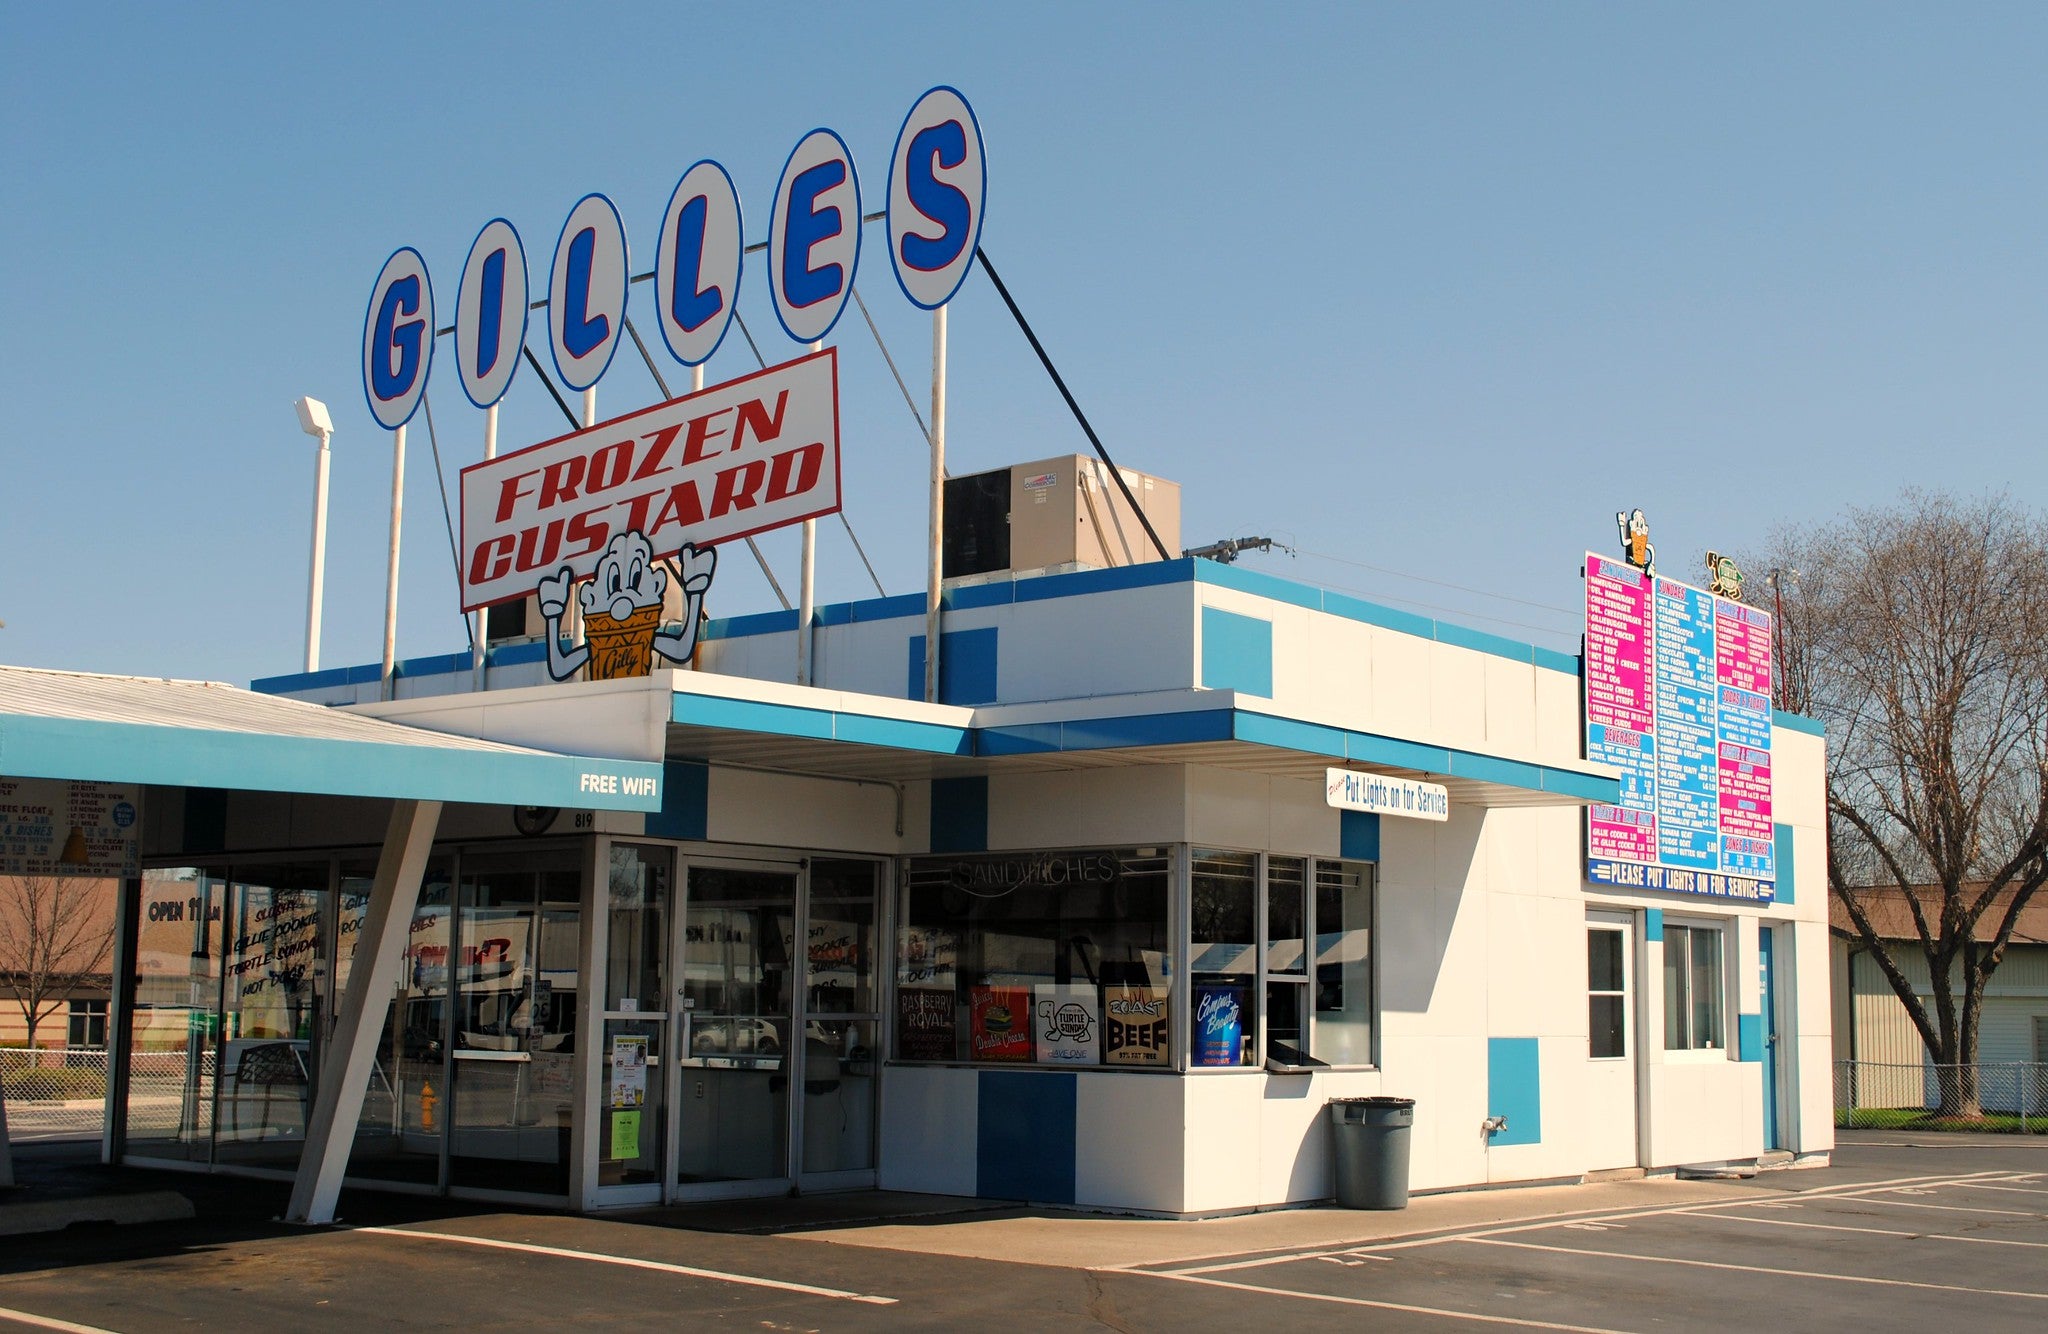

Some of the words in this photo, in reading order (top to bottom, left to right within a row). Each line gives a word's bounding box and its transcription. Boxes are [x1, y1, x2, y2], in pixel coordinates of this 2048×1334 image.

[371, 119, 971, 402] GILLES
[494, 389, 789, 523] FROZEN
[468, 442, 824, 586] CUSTARD
[1590, 577, 1622, 593] HAMBURGER
[1659, 579, 1686, 602] SUNDAES
[1658, 598, 1669, 608] HOT
[1670, 601, 1686, 613] FUDGE
[1658, 606, 1692, 623] STRAWBERRY
[1659, 615, 1680, 628] CARAMEL
[1591, 623, 1613, 636] GRILLED
[1614, 630, 1636, 643] CHICKEN
[1659, 622, 1695, 639] BUTTERSCOTCH
[1719, 624, 1745, 639] STRAWBERRY
[1591, 642, 1602, 652] HOT
[1659, 647, 1685, 661] CHOCOLATE
[1683, 645, 1701, 657] CHERRY
[603, 648, 638, 679] Gilly
[1591, 651, 1602, 661] HOT
[1621, 660, 1640, 671] CHEESE
[1592, 661, 1602, 671] HOT
[1604, 664, 1615, 674] DOG
[1659, 655, 1669, 664] OLD
[1609, 674, 1621, 684] DOG
[1592, 680, 1614, 692] GRILLED
[1615, 685, 1635, 698] CHEESE
[1659, 683, 1678, 695] TURTLE
[1593, 689, 1614, 702] CHICKEN
[1616, 695, 1634, 707] STRIPS
[1677, 695, 1695, 707] SPECIAL
[1722, 687, 1741, 706] SODAS
[1748, 694, 1767, 714] FLOATS
[1593, 703, 1613, 716] FRENCH
[1615, 709, 1630, 720] FRIES
[1593, 713, 1613, 725] CHEESE
[1614, 719, 1632, 730] CURDS
[1605, 728, 1641, 748] BEVERAGES
[1660, 729, 1680, 740] CAMPUS
[1660, 737, 1678, 747] PEANUT
[1679, 740, 1696, 751] BUTTER
[1684, 750, 1702, 760] DELIGHT
[1668, 771, 1687, 781] SPECIAL
[580, 773, 617, 794] FREE
[622, 776, 657, 797] WIFI
[1346, 774, 1359, 803] Put
[1362, 777, 1387, 810] Lights
[1390, 787, 1400, 808] on
[1403, 783, 1414, 810] for
[575, 813, 592, 828] 819
[1662, 806, 1677, 816] BLACK
[1682, 809, 1697, 819] WHITE
[5, 825, 12, 835] &
[17, 826, 54, 836] DISHES
[1593, 828, 1608, 837] GILLIE
[1610, 831, 1628, 840] COOKIE
[1662, 827, 1679, 838] BANANA
[1601, 839, 1617, 848] GILLIE
[1618, 841, 1636, 851] COOKIE
[1662, 837, 1679, 846] FUDGE
[1680, 839, 1692, 848] BOAT
[1750, 840, 1769, 857] DISHES
[1662, 846, 1679, 856] PEANUT
[1679, 848, 1696, 858] BUTTER
[955, 855, 1114, 887] SANDWICHES
[1611, 862, 1644, 886] PLEASE
[1646, 866, 1664, 887] PUT
[1666, 868, 1695, 892] LIGHTS
[1697, 873, 1709, 893] ON
[1711, 875, 1726, 895] FOR
[1728, 876, 1759, 899] SERVICE
[345, 892, 369, 911] GILL
[149, 901, 183, 922] OPEN
[274, 912, 321, 938] COOKIE
[227, 952, 272, 978] TURTLE
[242, 978, 266, 997] HOT
[1109, 999, 1164, 1017] ROAST
[1197, 992, 1234, 1022] Campus
[909, 1012, 946, 1029] ROYAL
[1059, 1013, 1085, 1023] TURTLE
[1207, 1003, 1240, 1035] Beauty
[1107, 1016, 1167, 1052] BEEF
